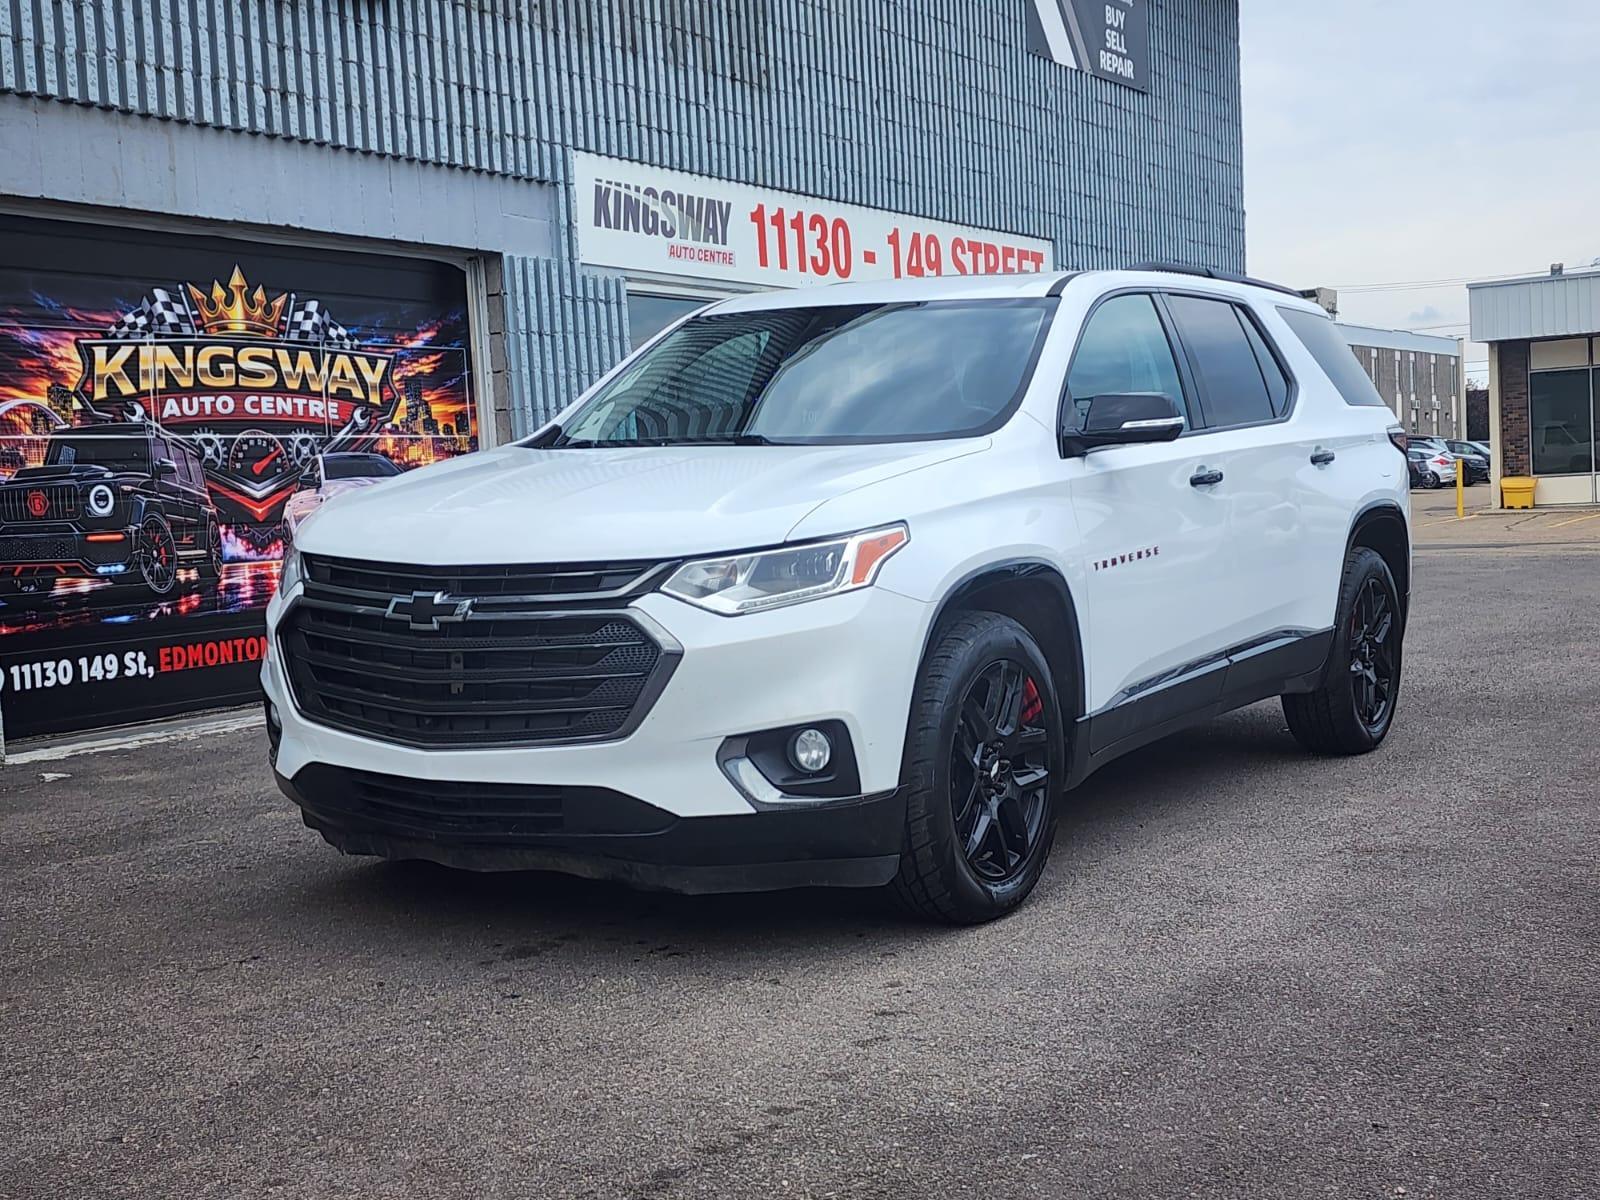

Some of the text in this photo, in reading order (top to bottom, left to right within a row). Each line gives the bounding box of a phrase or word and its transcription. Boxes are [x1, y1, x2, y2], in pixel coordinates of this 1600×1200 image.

[1105, 4, 1126, 30] BUY
[1105, 28, 1128, 54] SELL
[1099, 49, 1134, 80] REPAIR
[593, 178, 732, 246] KINGSWAY
[669, 244, 734, 265] AUTO CENTRE
[750, 203, 852, 279] 11130
[887, 227, 942, 279] 149
[92, 345, 389, 405] KINGSWAY
[161, 395, 340, 420] AUTO CENTRE
[1093, 546, 1160, 571] TRAVERSE
[10, 659, 73, 691] 11130
[78, 653, 119, 682] 149
[124, 651, 155, 679] St,
